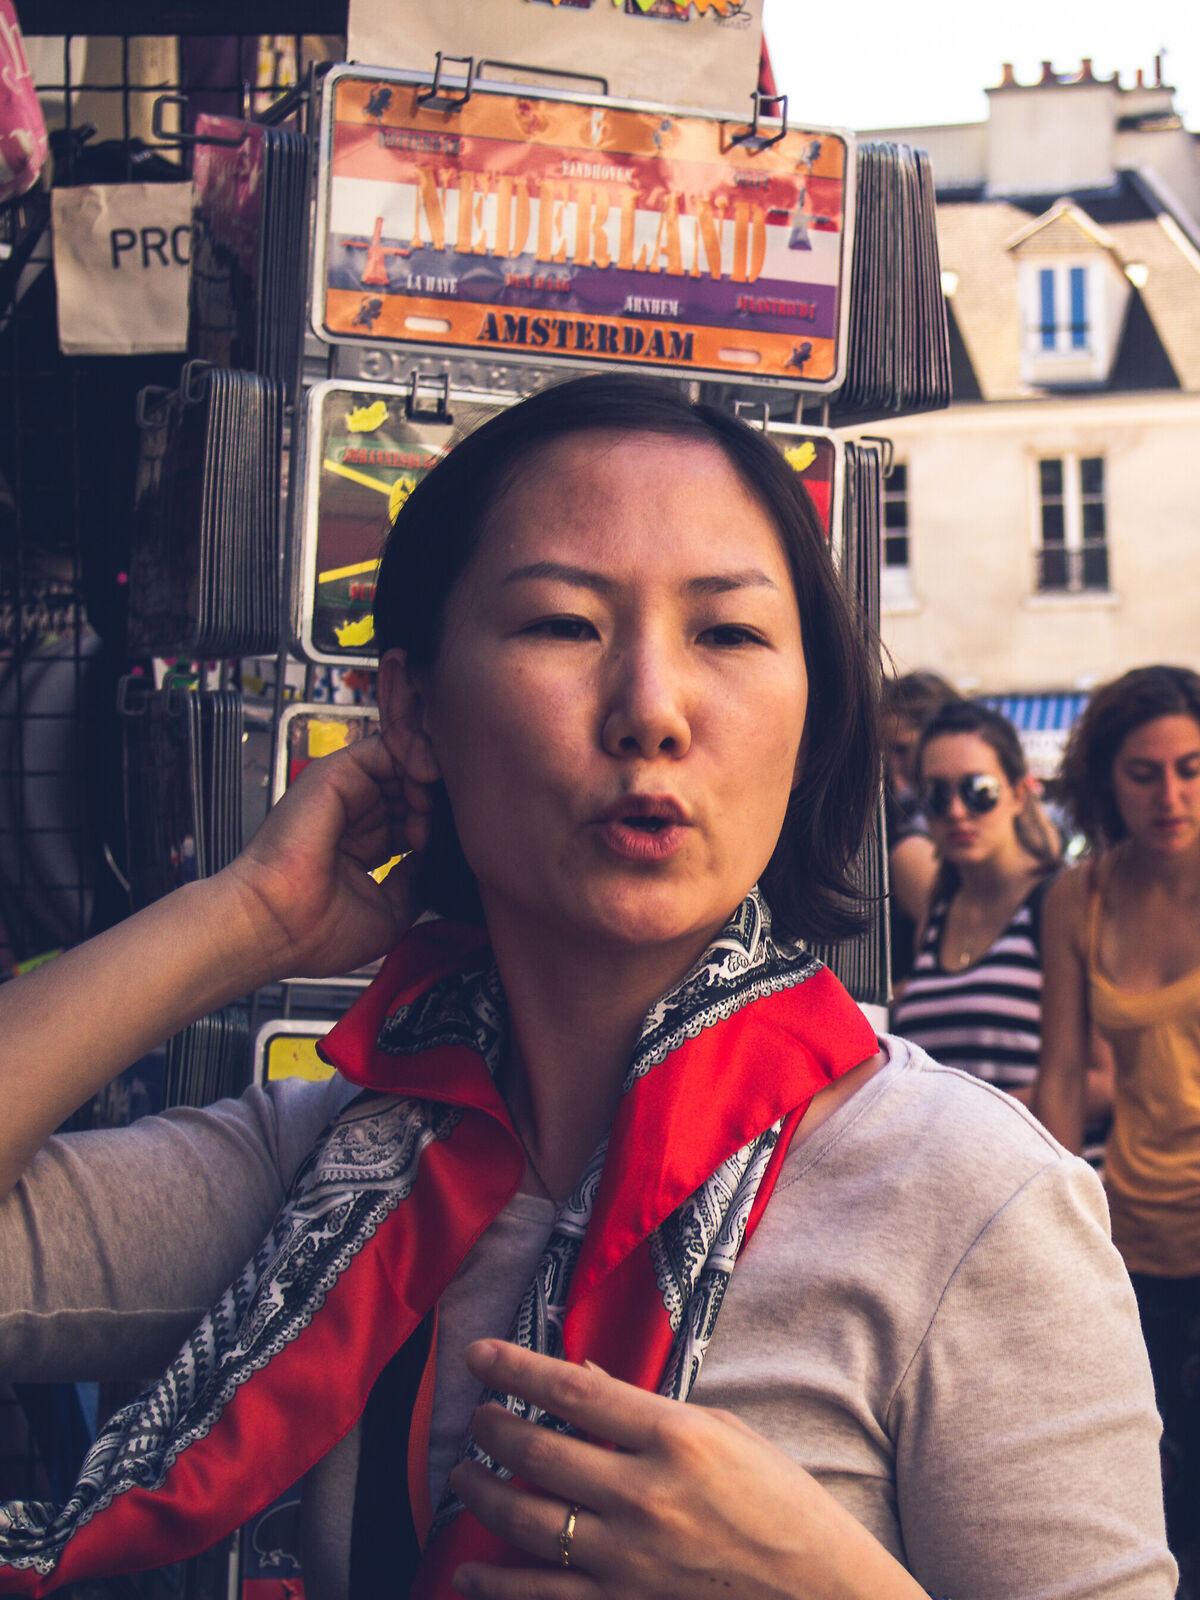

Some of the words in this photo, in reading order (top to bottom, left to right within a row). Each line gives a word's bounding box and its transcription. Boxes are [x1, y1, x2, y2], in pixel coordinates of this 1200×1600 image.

[411, 166, 767, 283] NEDERLAND
[407, 273, 422, 291] LA
[426, 276, 458, 295] HAYE
[624, 295, 680, 317] ARNHEM
[736, 295, 817, 320] MAASTRICHT
[477, 312, 695, 361] AMSTERDAM
